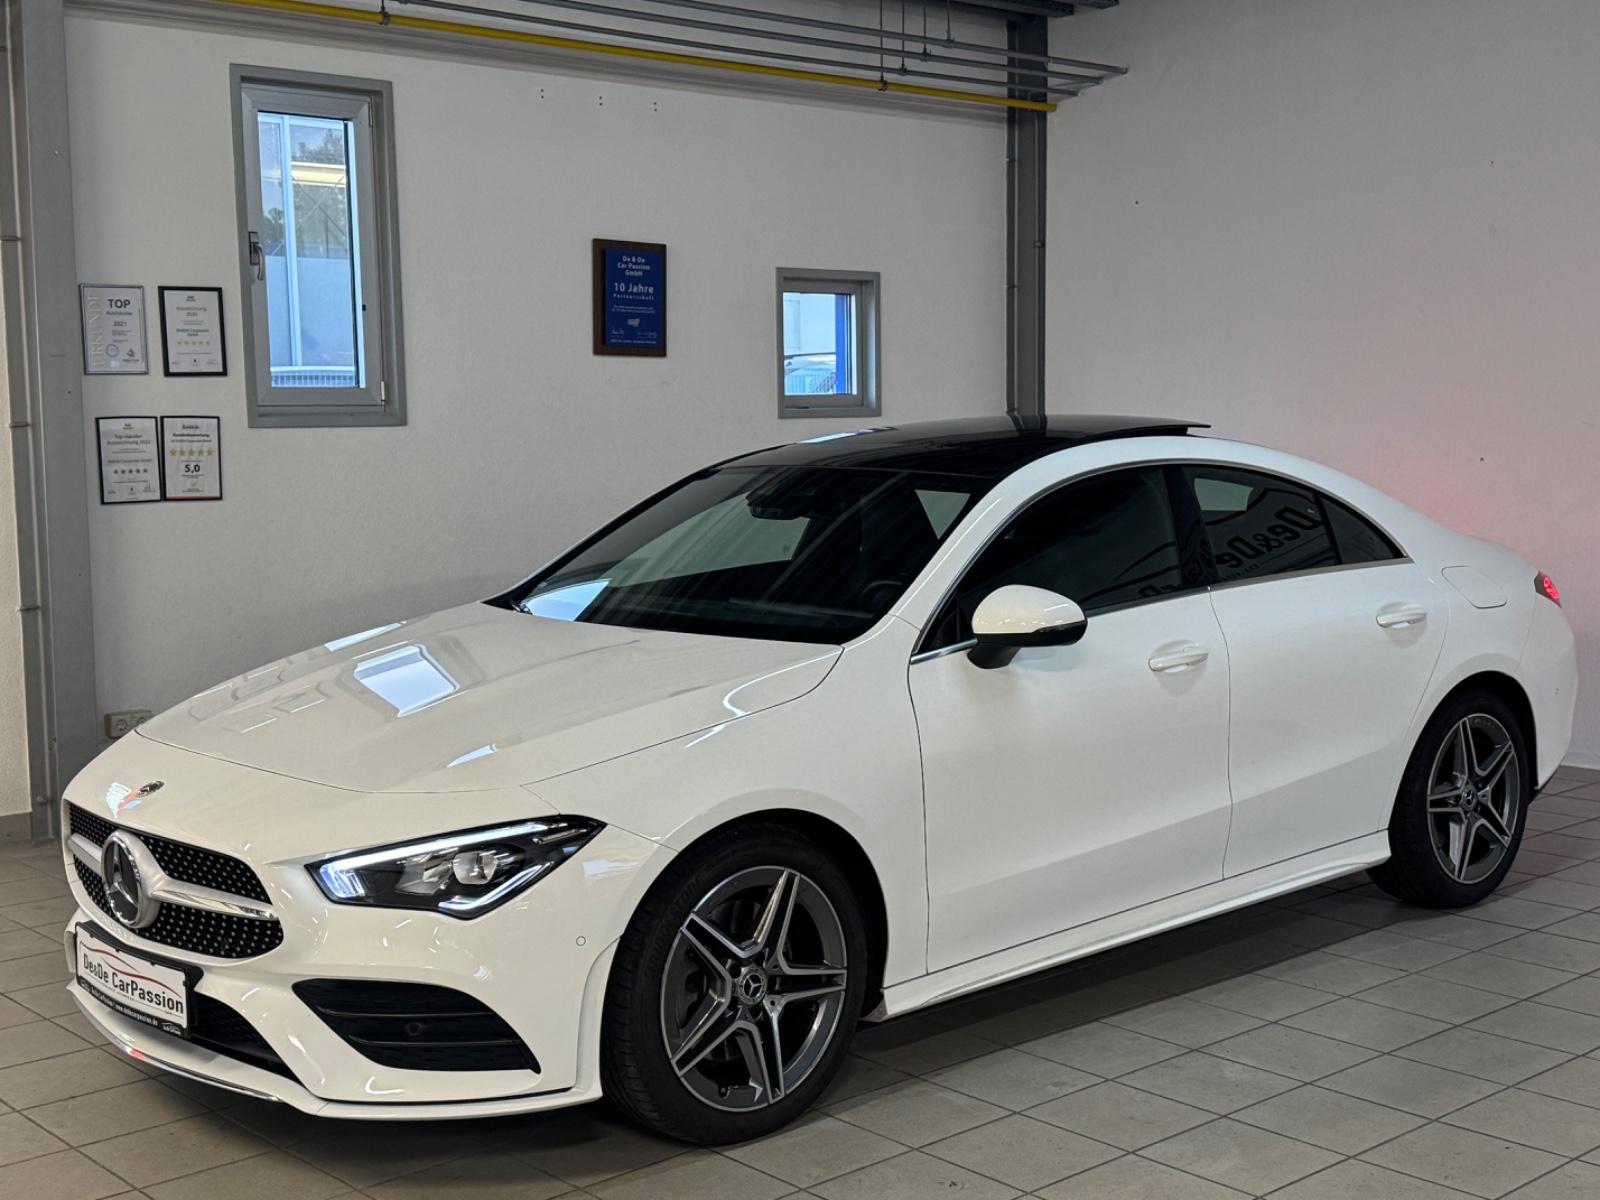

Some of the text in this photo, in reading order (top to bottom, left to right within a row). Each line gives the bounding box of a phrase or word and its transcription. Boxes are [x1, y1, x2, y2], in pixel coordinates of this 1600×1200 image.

[617, 261, 651, 270] Car Passion
[614, 282, 654, 294] 10 Jahre
[612, 293, 655, 301] Partnerschaft
[107, 298, 131, 309] TOP
[184, 464, 200, 474] 5,0
[111, 972, 185, 1015] CarPassion
